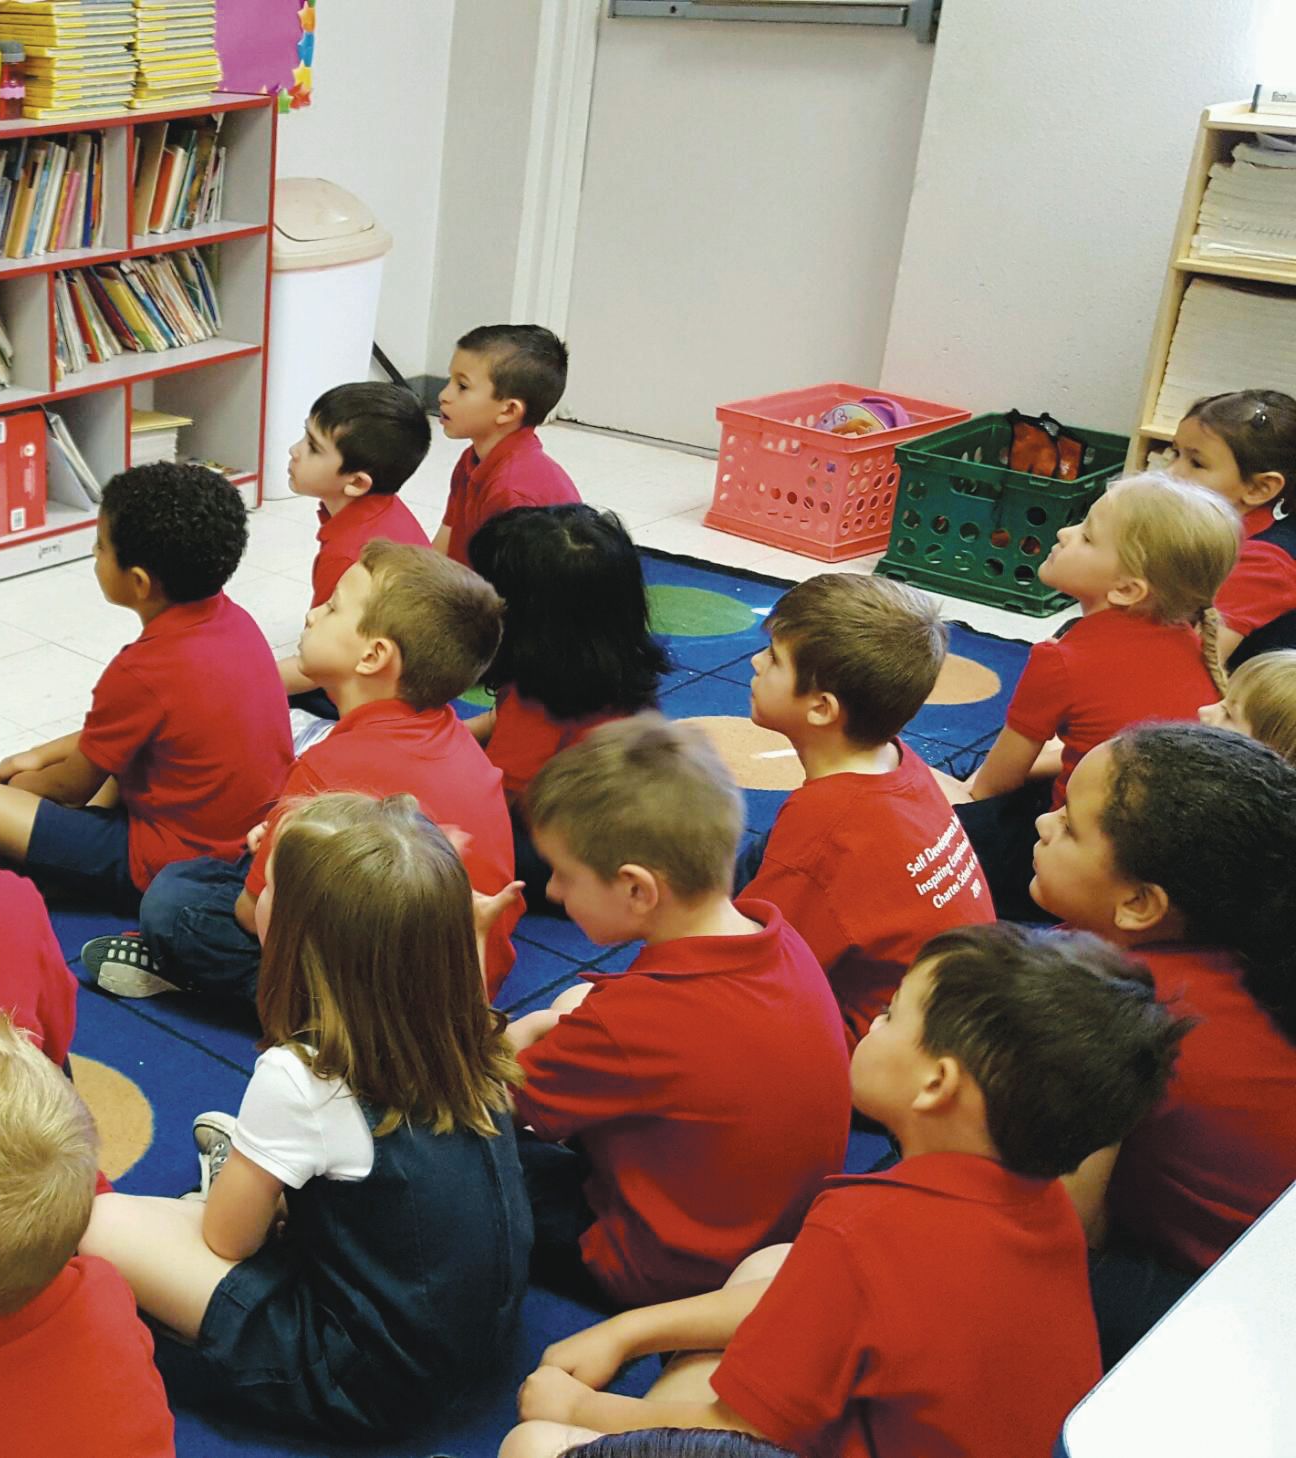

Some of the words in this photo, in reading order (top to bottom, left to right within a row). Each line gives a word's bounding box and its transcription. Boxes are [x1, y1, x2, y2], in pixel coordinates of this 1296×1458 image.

[906, 854, 928, 877] Self
[915, 863, 954, 895] Inspiring
[933, 882, 960, 908] Charter
